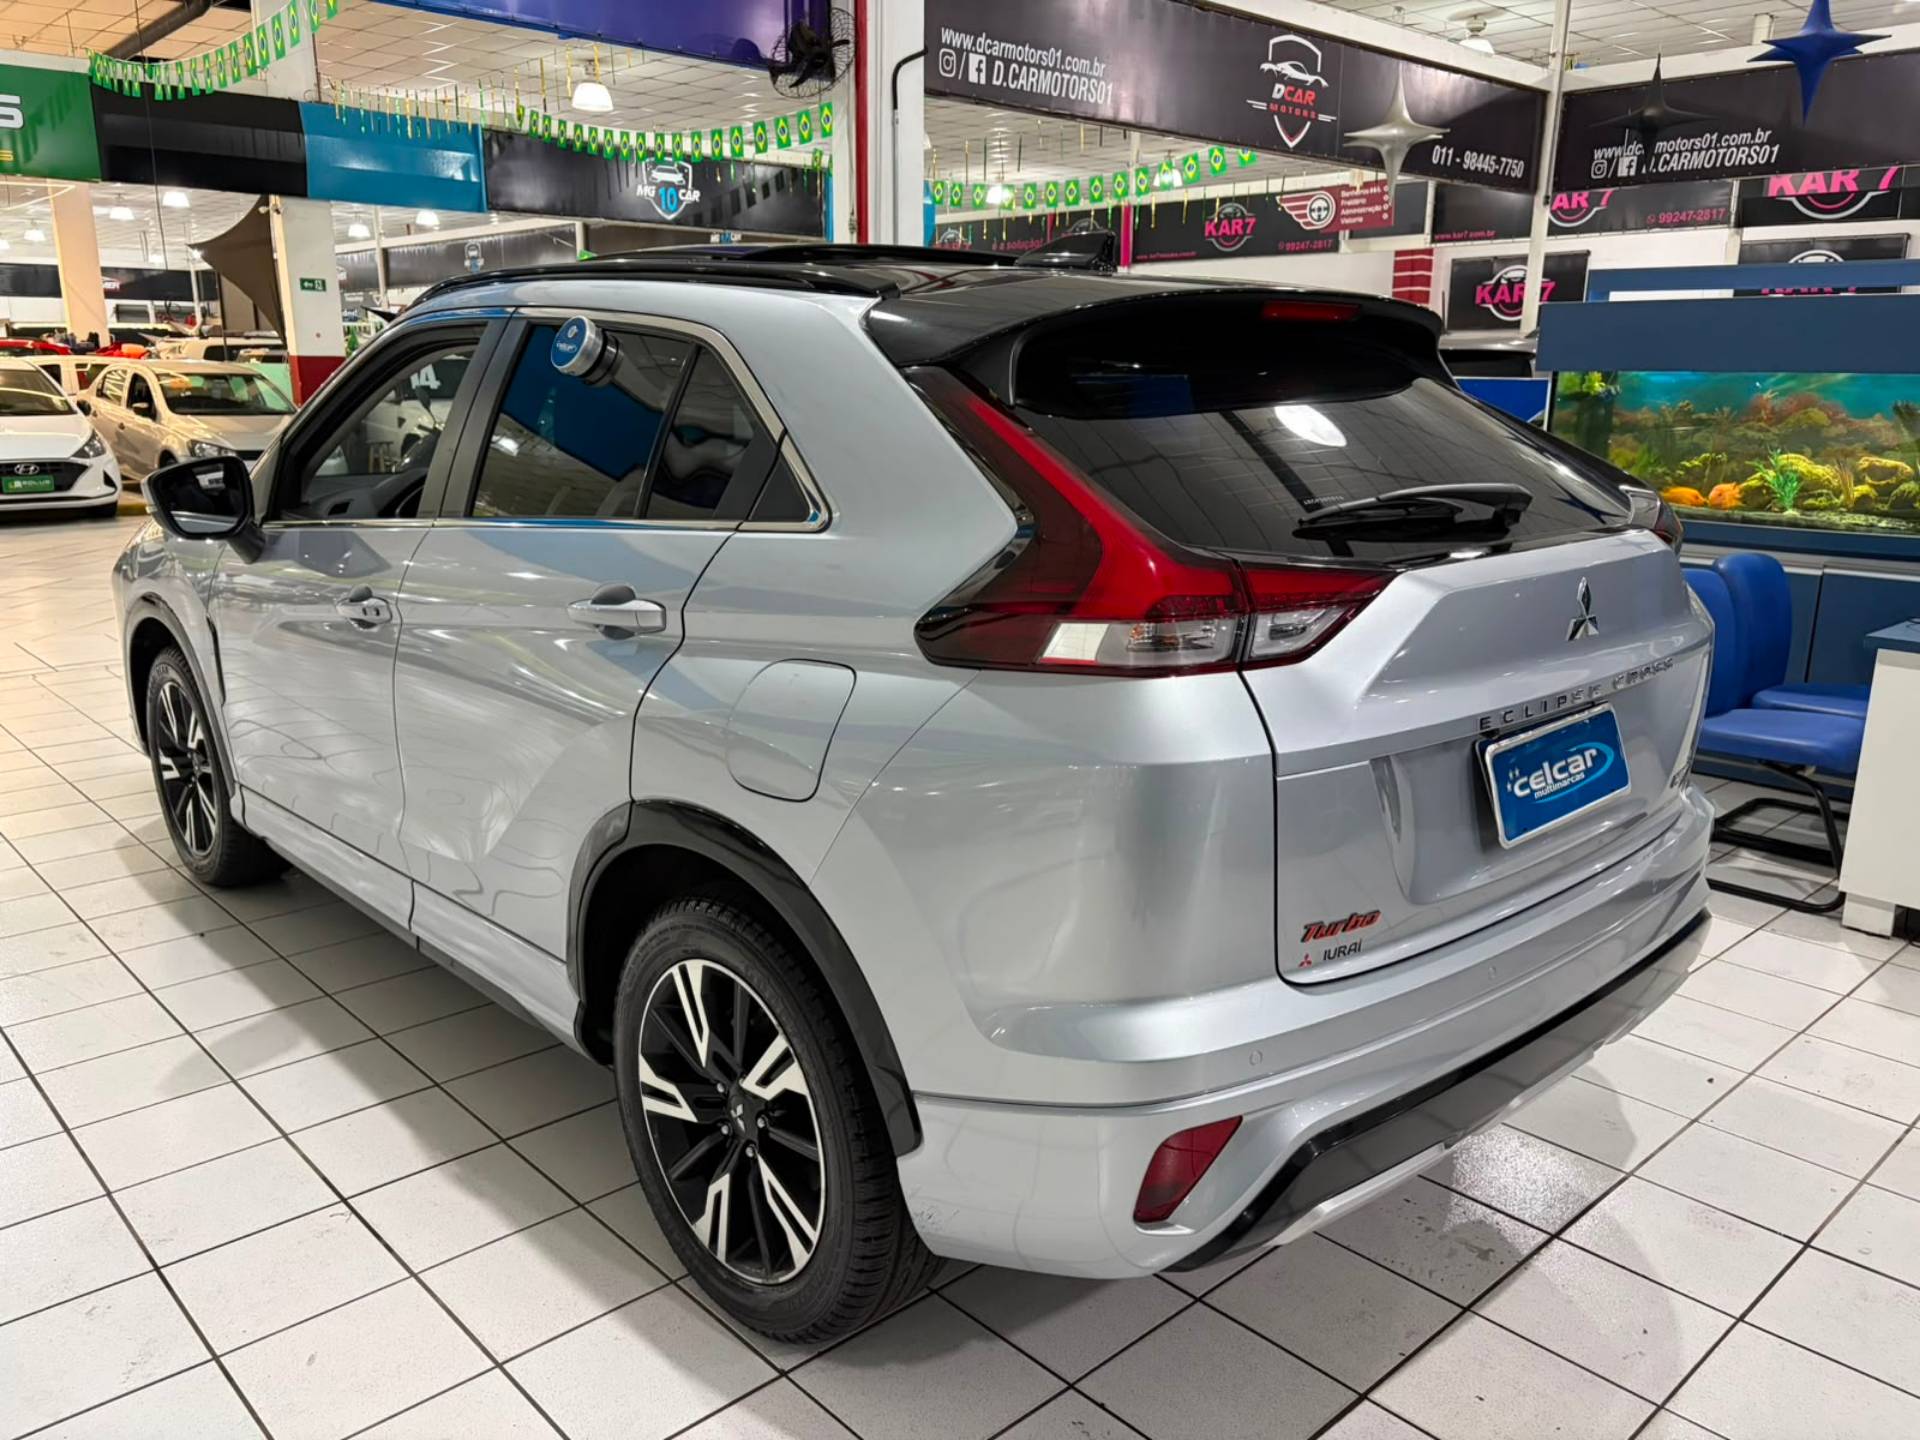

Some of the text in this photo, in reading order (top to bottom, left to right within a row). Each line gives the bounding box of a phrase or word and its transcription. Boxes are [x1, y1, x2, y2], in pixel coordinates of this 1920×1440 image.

[941, 27, 1106, 77] www.dcarmotors01.com.br
[992, 60, 1113, 105] D.CARMOTORS01
[1271, 83, 1316, 105] DCAR
[1270, 103, 1316, 119] MOTORS
[1432, 145, 1454, 167] 011
[1462, 150, 1525, 178] 98445-7750
[636, 184, 701, 213] MG 10 CAR
[1540, 281, 1556, 304] 7
[1480, 685, 1603, 730] ECLIPSE
[1513, 748, 1597, 798] celcar
[1534, 772, 1585, 800] multimarcas
[1300, 909, 1381, 943] Turbo
